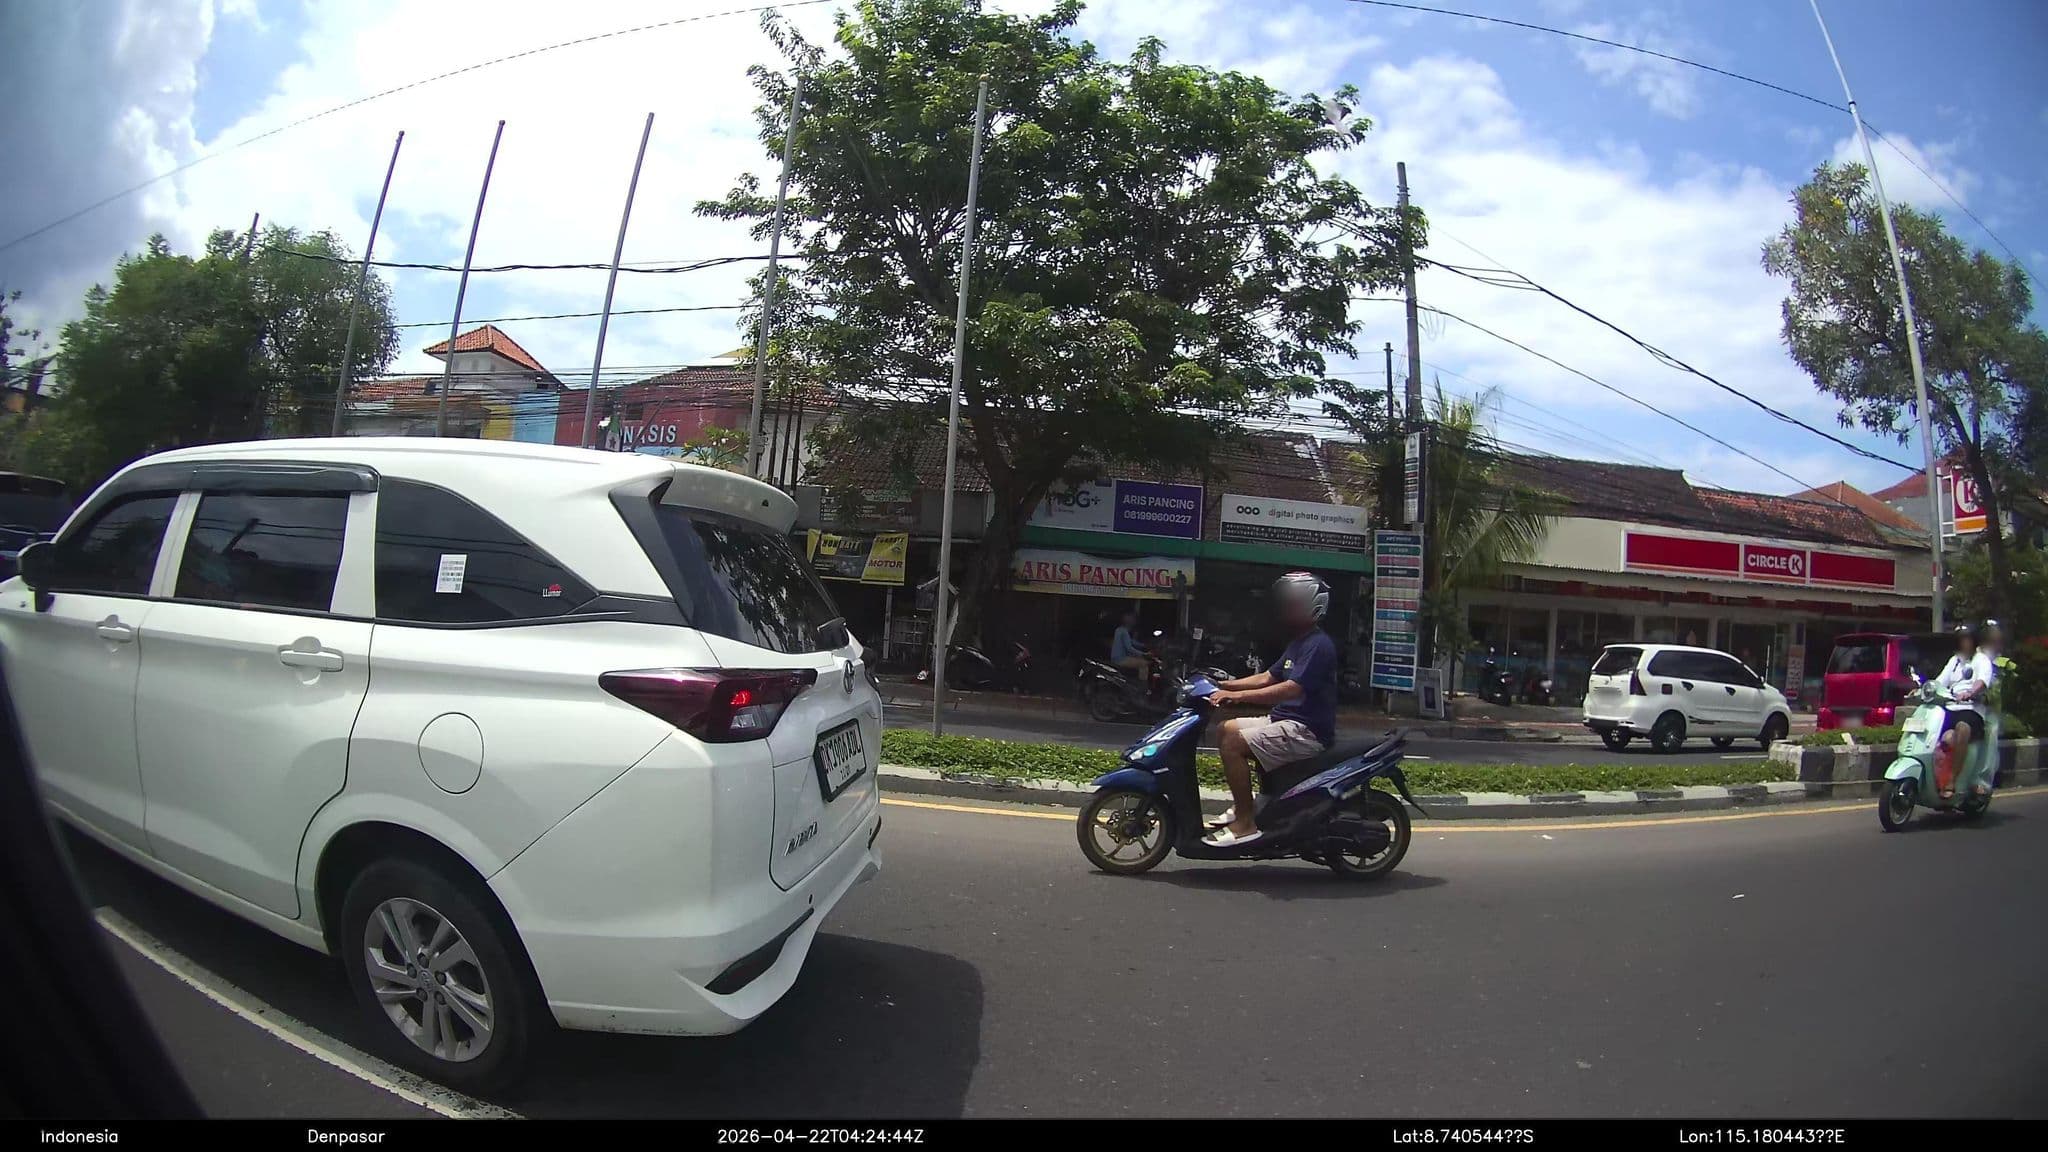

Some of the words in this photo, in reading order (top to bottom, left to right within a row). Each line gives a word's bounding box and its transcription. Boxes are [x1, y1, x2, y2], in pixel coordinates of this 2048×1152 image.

[1123, 494, 1147, 506] ARIS
[1148, 496, 1195, 510] PANCING
[1268, 507, 1294, 519] digital
[1296, 511, 1319, 520] photo
[1321, 514, 1354, 524] graphics
[868, 559, 903, 569] MOTOR
[1747, 553, 1787, 570] CIRCLE
[1788, 554, 1803, 575] K
[1021, 560, 1072, 582] ARIS
[1079, 563, 1170, 587] PANCING
